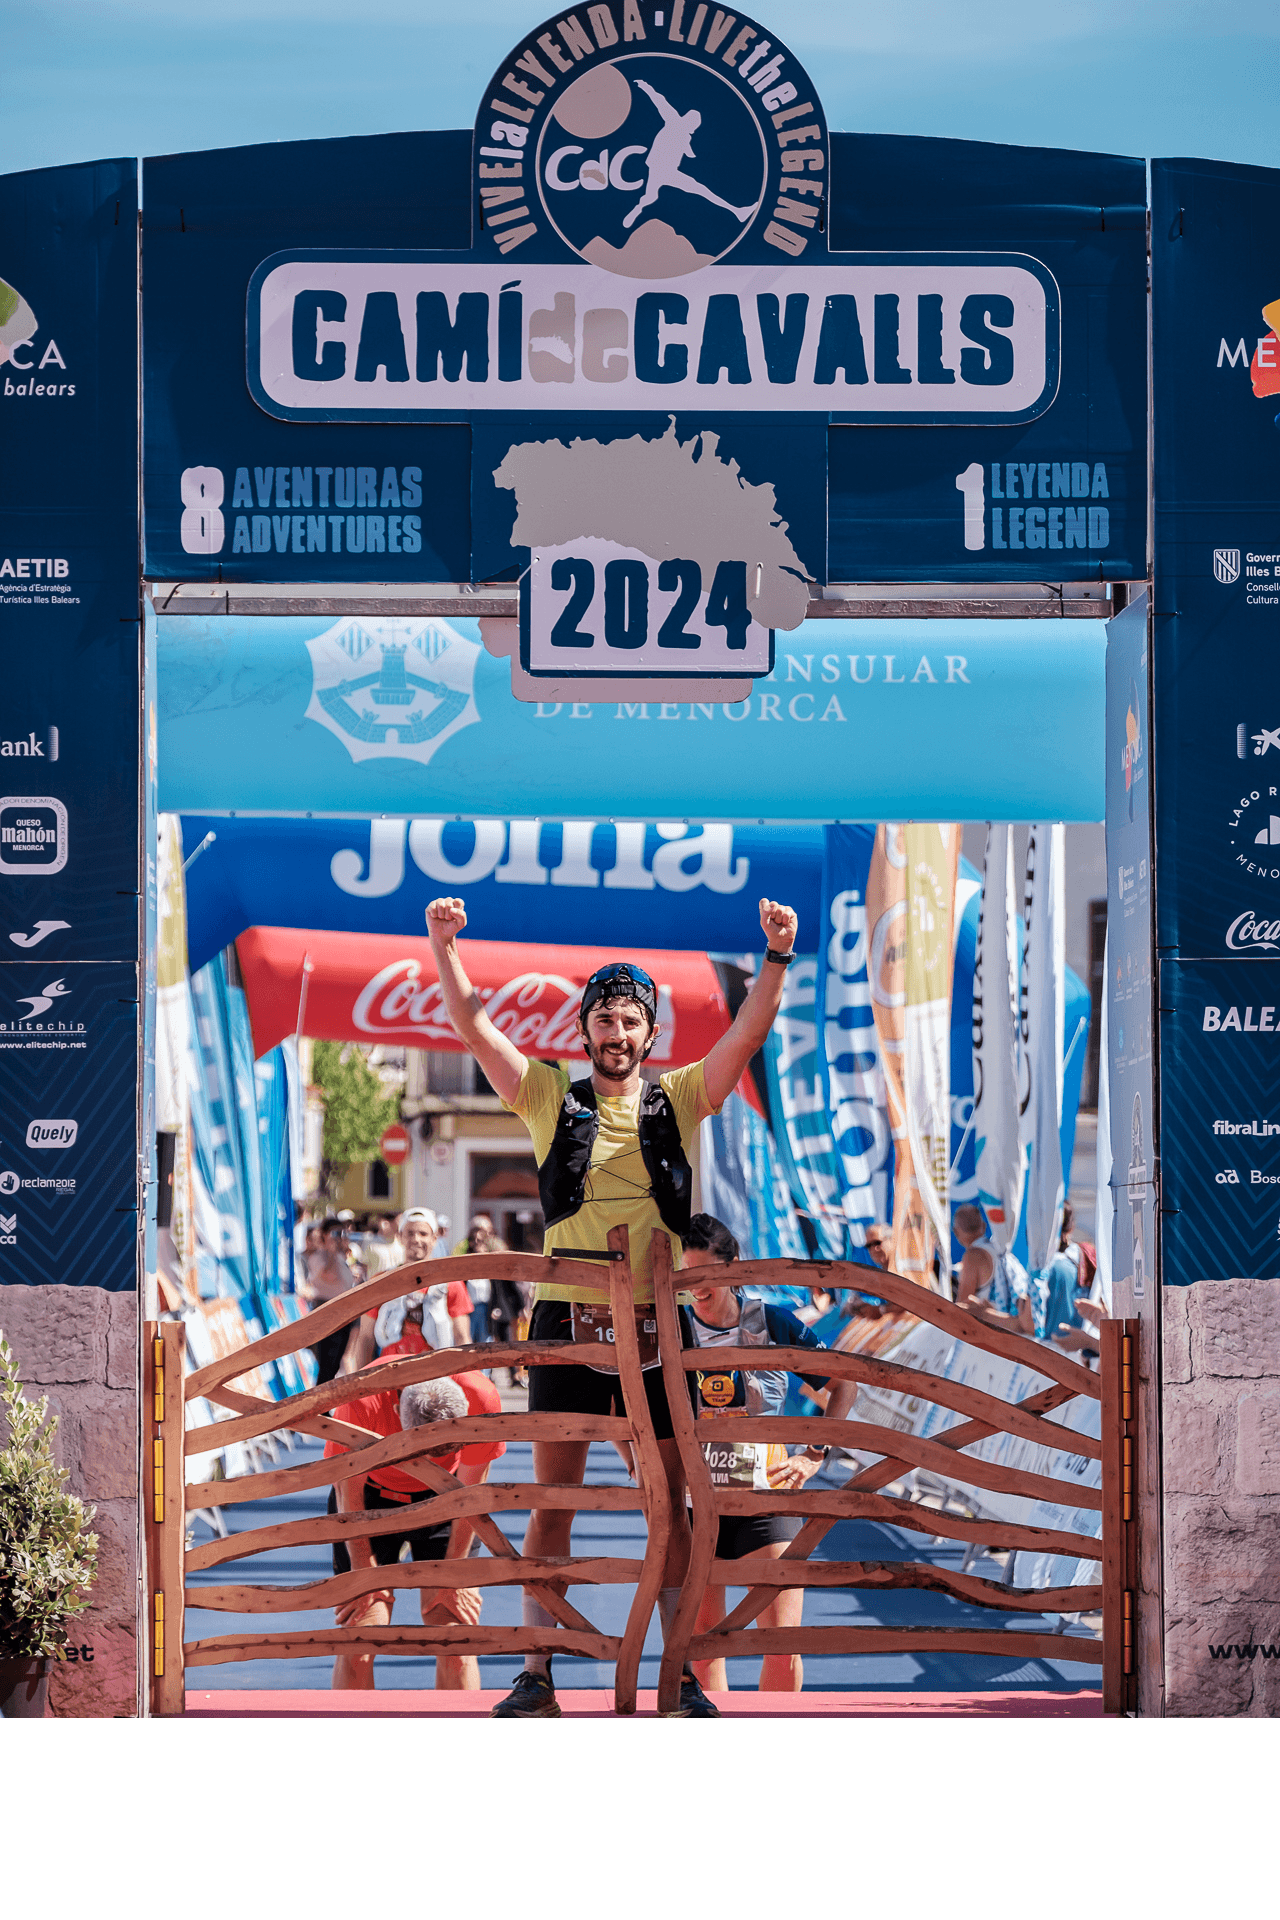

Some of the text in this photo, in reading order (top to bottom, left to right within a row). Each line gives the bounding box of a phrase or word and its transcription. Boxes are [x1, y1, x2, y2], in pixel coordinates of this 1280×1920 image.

[544, 145, 648, 191] CdC
[4, 377, 76, 397] balears
[231, 466, 423, 508] AVENTURAS
[991, 462, 1110, 499] LEYENDA
[180, 465, 225, 554] 8
[955, 462, 986, 551] 1
[231, 515, 423, 554] ADVENTURES
[991, 506, 1110, 549] LEGEND
[0, 558, 70, 578] AETIB
[1246, 566, 1270, 577] Illes
[51, 595, 81, 604] Balears
[549, 556, 754, 651] 2024
[1246, 595, 1279, 605] Cultura
[1229, 790, 1260, 827] LAGO
[16, 819, 41, 827] QUESO
[0, 1021, 85, 1031] elitechip
[1202, 1006, 1280, 1032] BALE
[0, 1041, 87, 1050] www.elitechip.net
[30, 1125, 74, 1143] Quely
